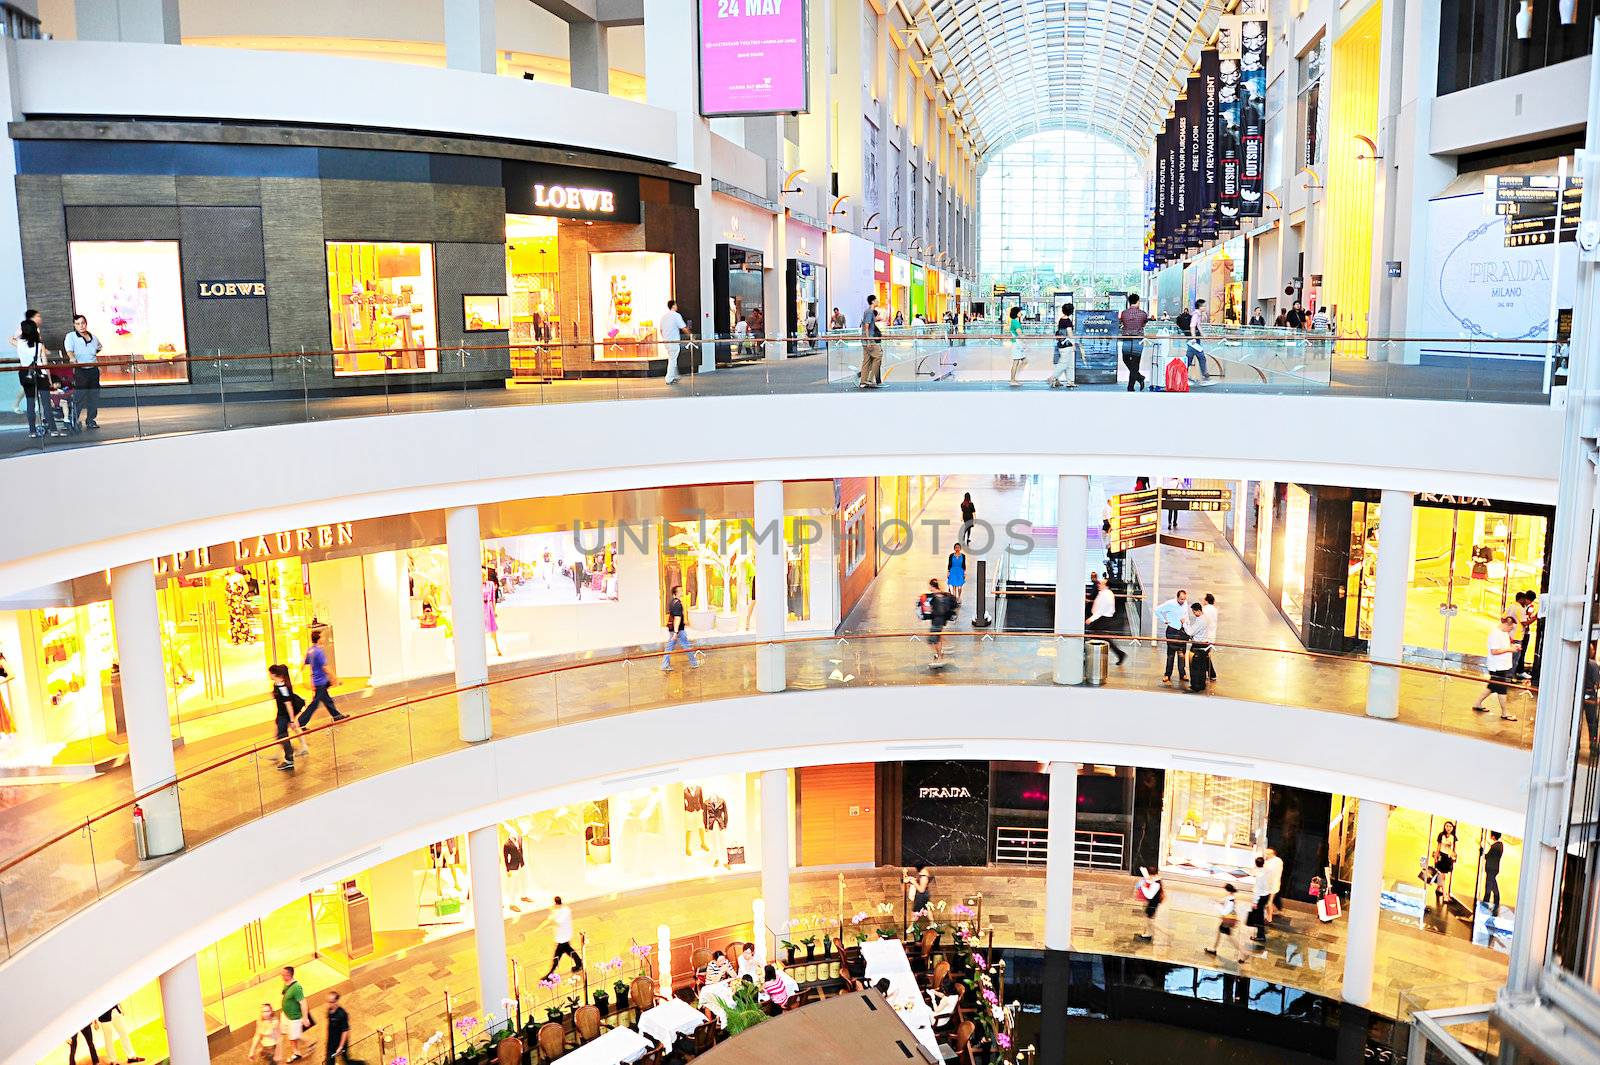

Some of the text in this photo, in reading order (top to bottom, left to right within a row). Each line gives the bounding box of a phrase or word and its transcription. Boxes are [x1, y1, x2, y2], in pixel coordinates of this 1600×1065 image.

[718, 0, 783, 18] 24 MAY
[1179, 117, 1187, 153] PURCHASES
[1207, 74, 1215, 184] MY REWARDING MOMENT
[1247, 125, 1258, 135] IN
[1192, 143, 1199, 153] TO
[1225, 150, 1235, 159] IN
[1246, 139, 1258, 177] OUTSIDE
[1179, 173, 1185, 183] ON
[1225, 162, 1235, 195] OUTSIDE
[534, 184, 615, 213] LOEWE
[1159, 208, 1165, 216] AT
[1468, 259, 1550, 283] PRADA
[199, 282, 266, 297] LOEWE
[1491, 287, 1522, 298] MILANO
[1419, 492, 1492, 507] RADA
[234, 523, 354, 562] LAUREN
[919, 787, 971, 798] PRADA
